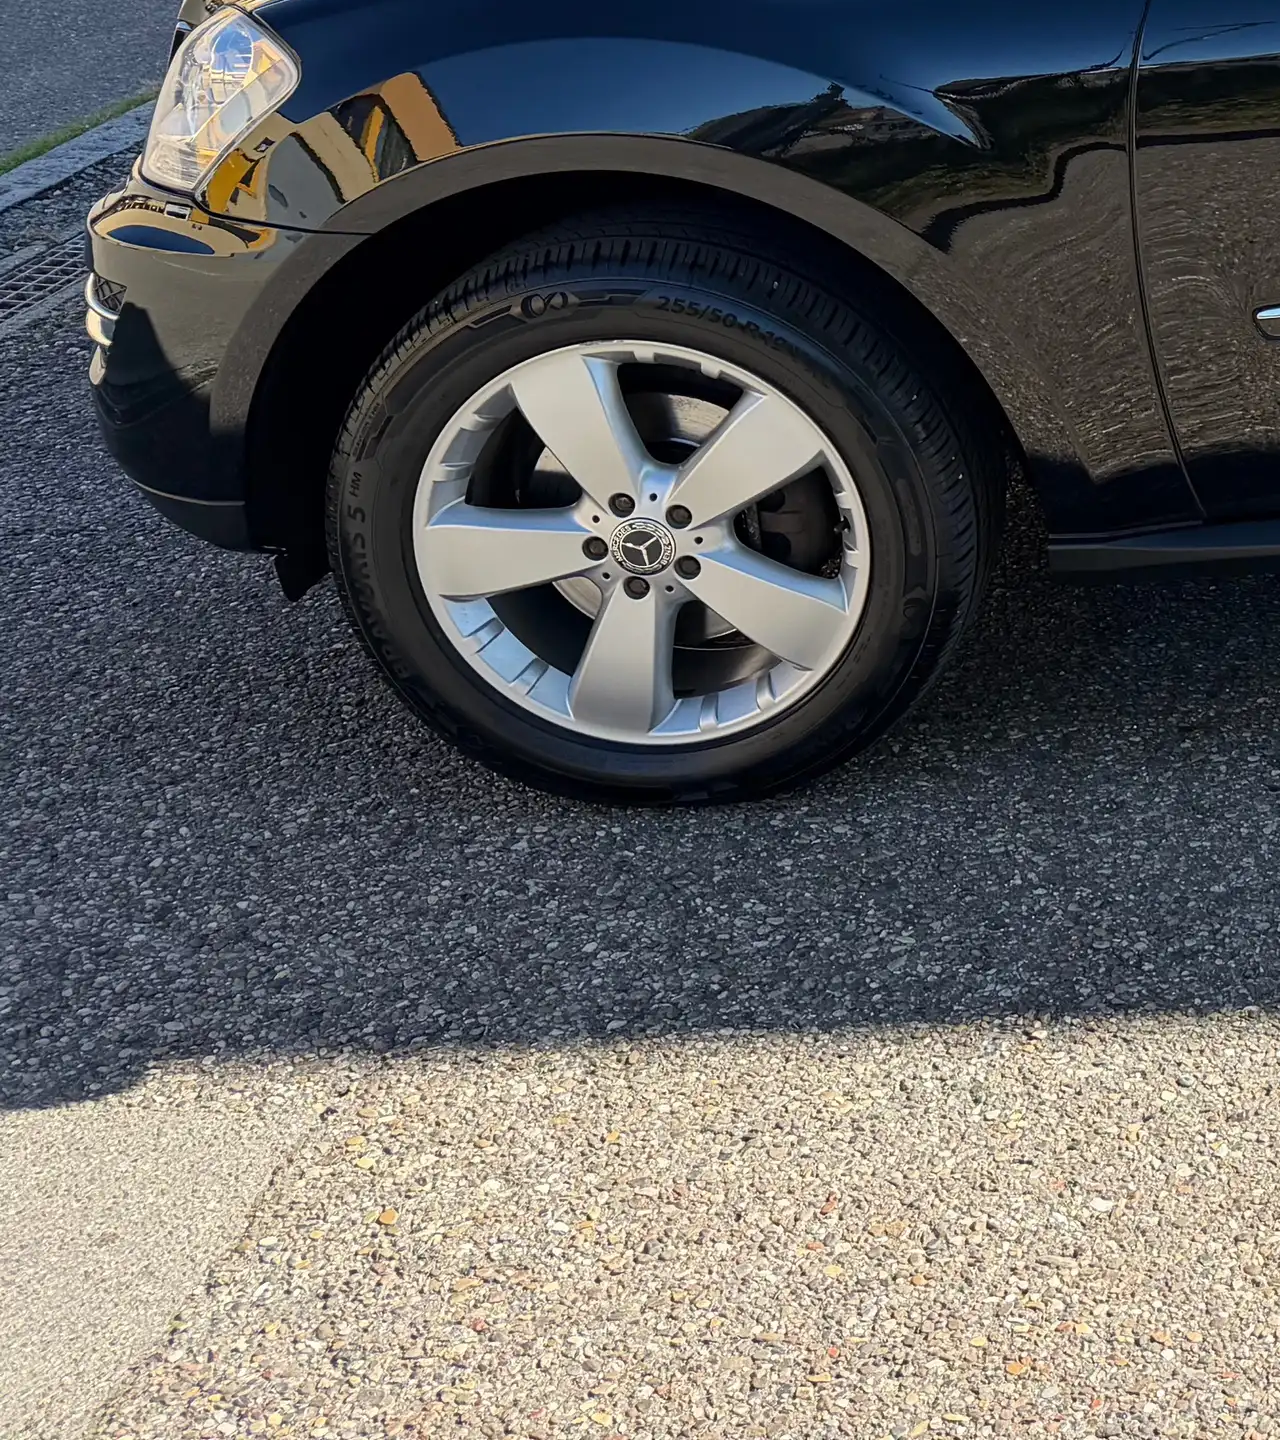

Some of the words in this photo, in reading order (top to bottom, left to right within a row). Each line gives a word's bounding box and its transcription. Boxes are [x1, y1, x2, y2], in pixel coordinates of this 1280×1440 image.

[655, 295, 738, 329] 255/50
[349, 470, 364, 500] HM
[346, 503, 367, 525] 5
